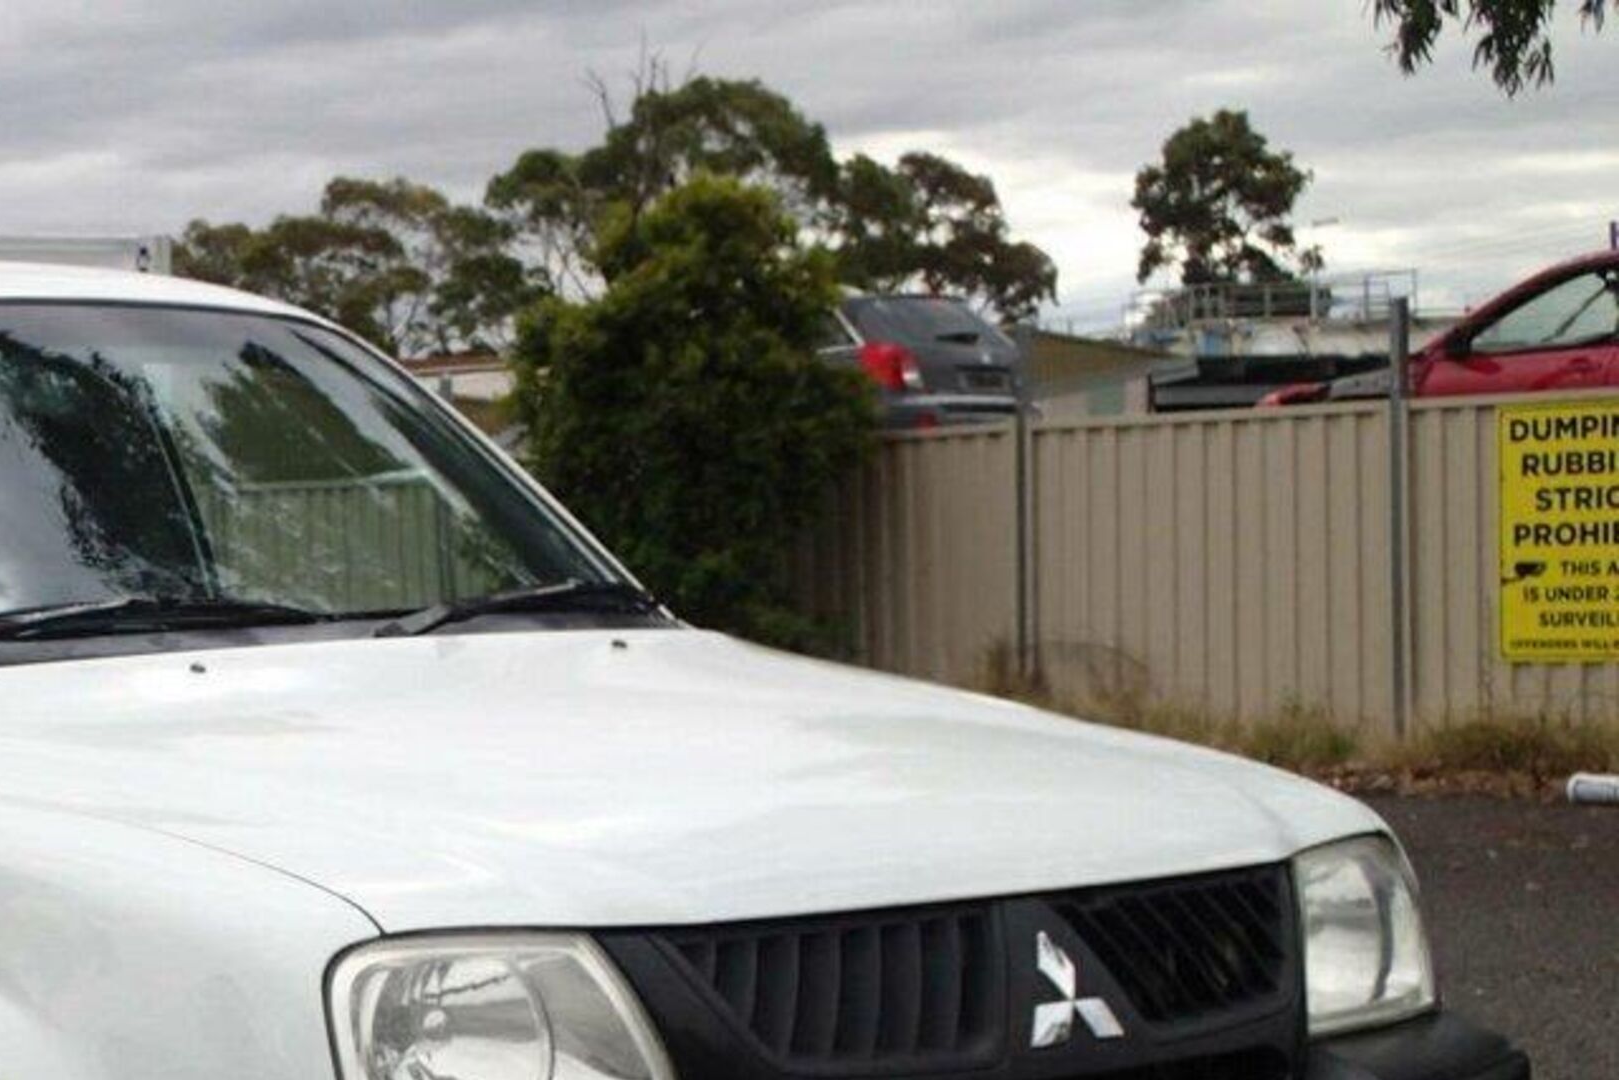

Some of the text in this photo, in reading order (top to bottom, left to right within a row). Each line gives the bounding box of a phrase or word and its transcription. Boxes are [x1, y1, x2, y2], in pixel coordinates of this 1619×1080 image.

[1560, 561, 1601, 576] THIS
[1523, 586, 1539, 603] IS
[1545, 585, 1609, 601] UNDER
